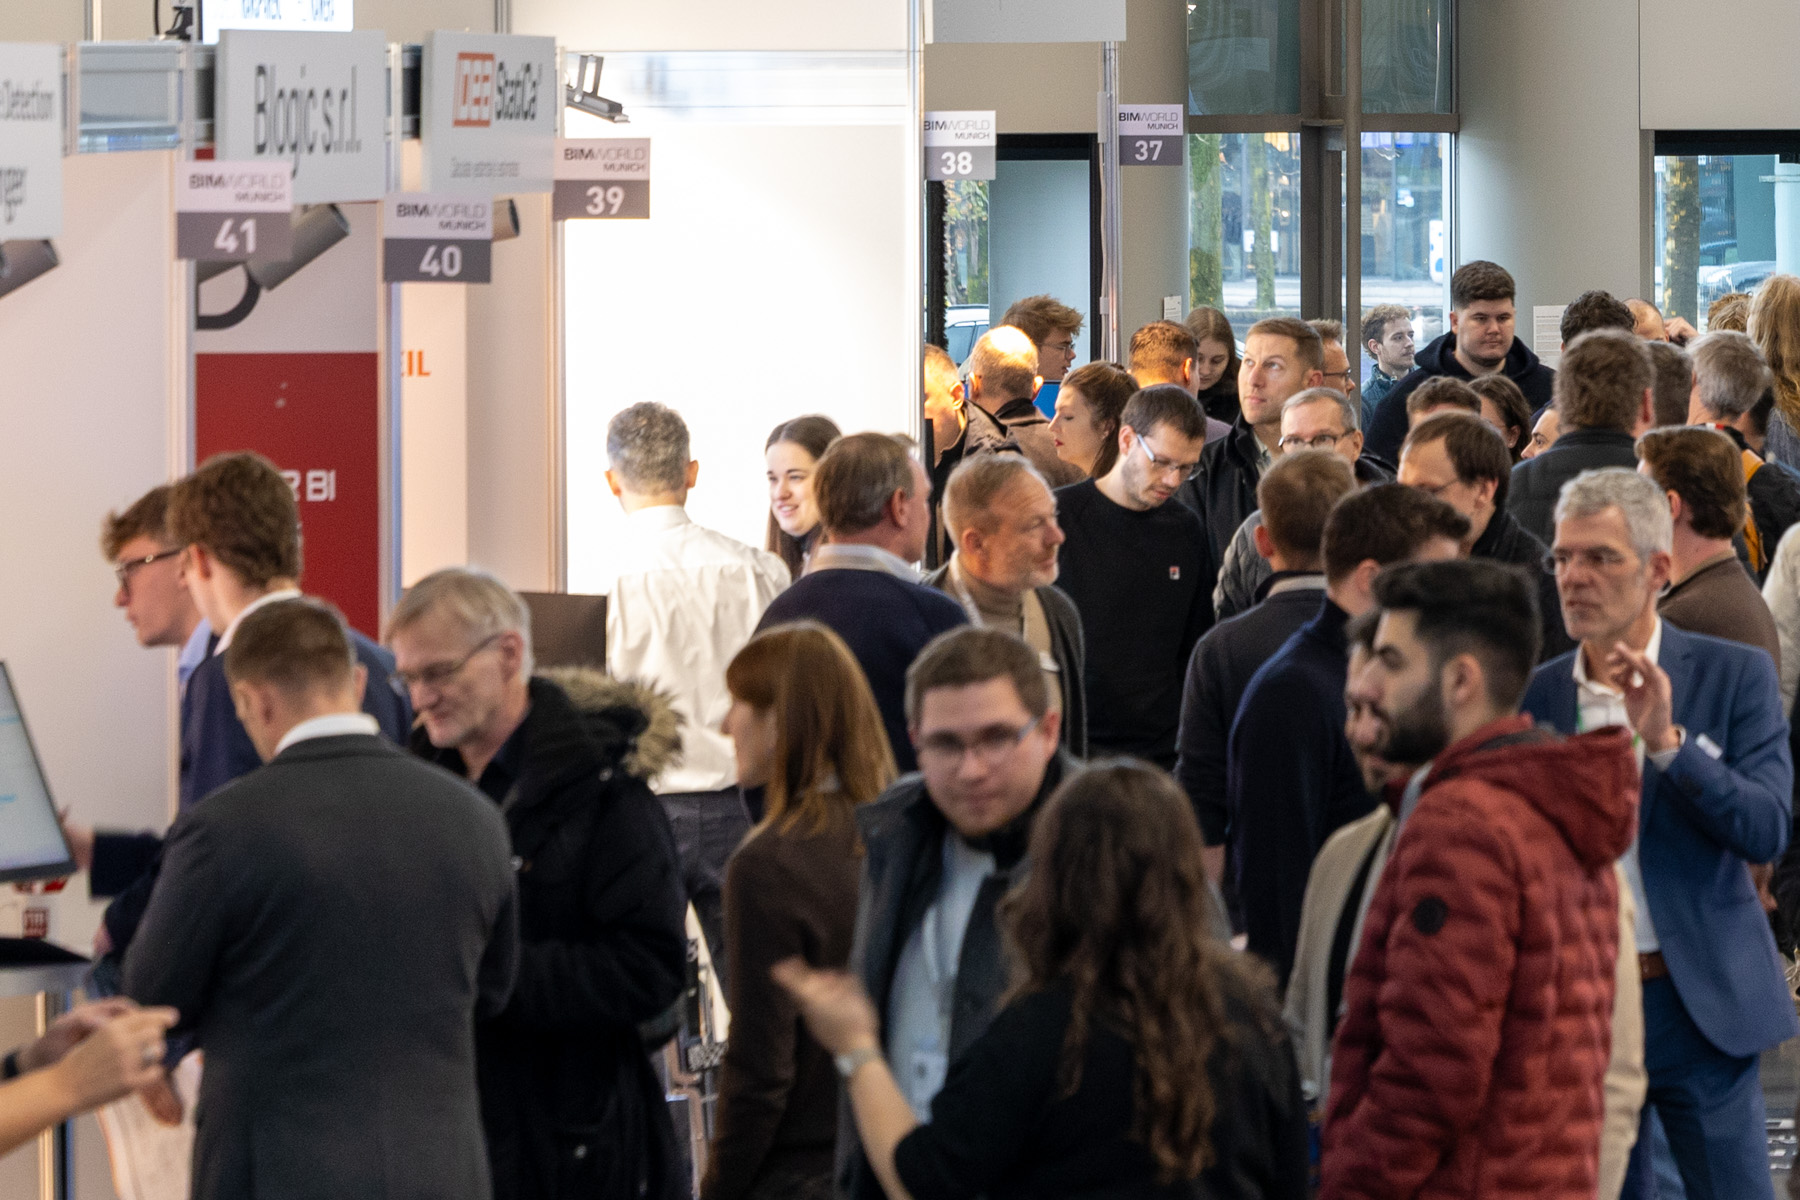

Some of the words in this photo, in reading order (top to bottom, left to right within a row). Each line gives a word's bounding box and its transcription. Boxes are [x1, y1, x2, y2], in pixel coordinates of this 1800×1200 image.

[255, 63, 318, 179] Blogic
[1119, 112, 1180, 123] BIMWORLD
[1147, 122, 1179, 131] MUNICH
[955, 131, 991, 141] MUNICH
[1134, 140, 1163, 162] 37
[940, 152, 973, 176] 38
[584, 186, 625, 215] 39
[213, 221, 256, 254] 41
[419, 247, 462, 277] 40
